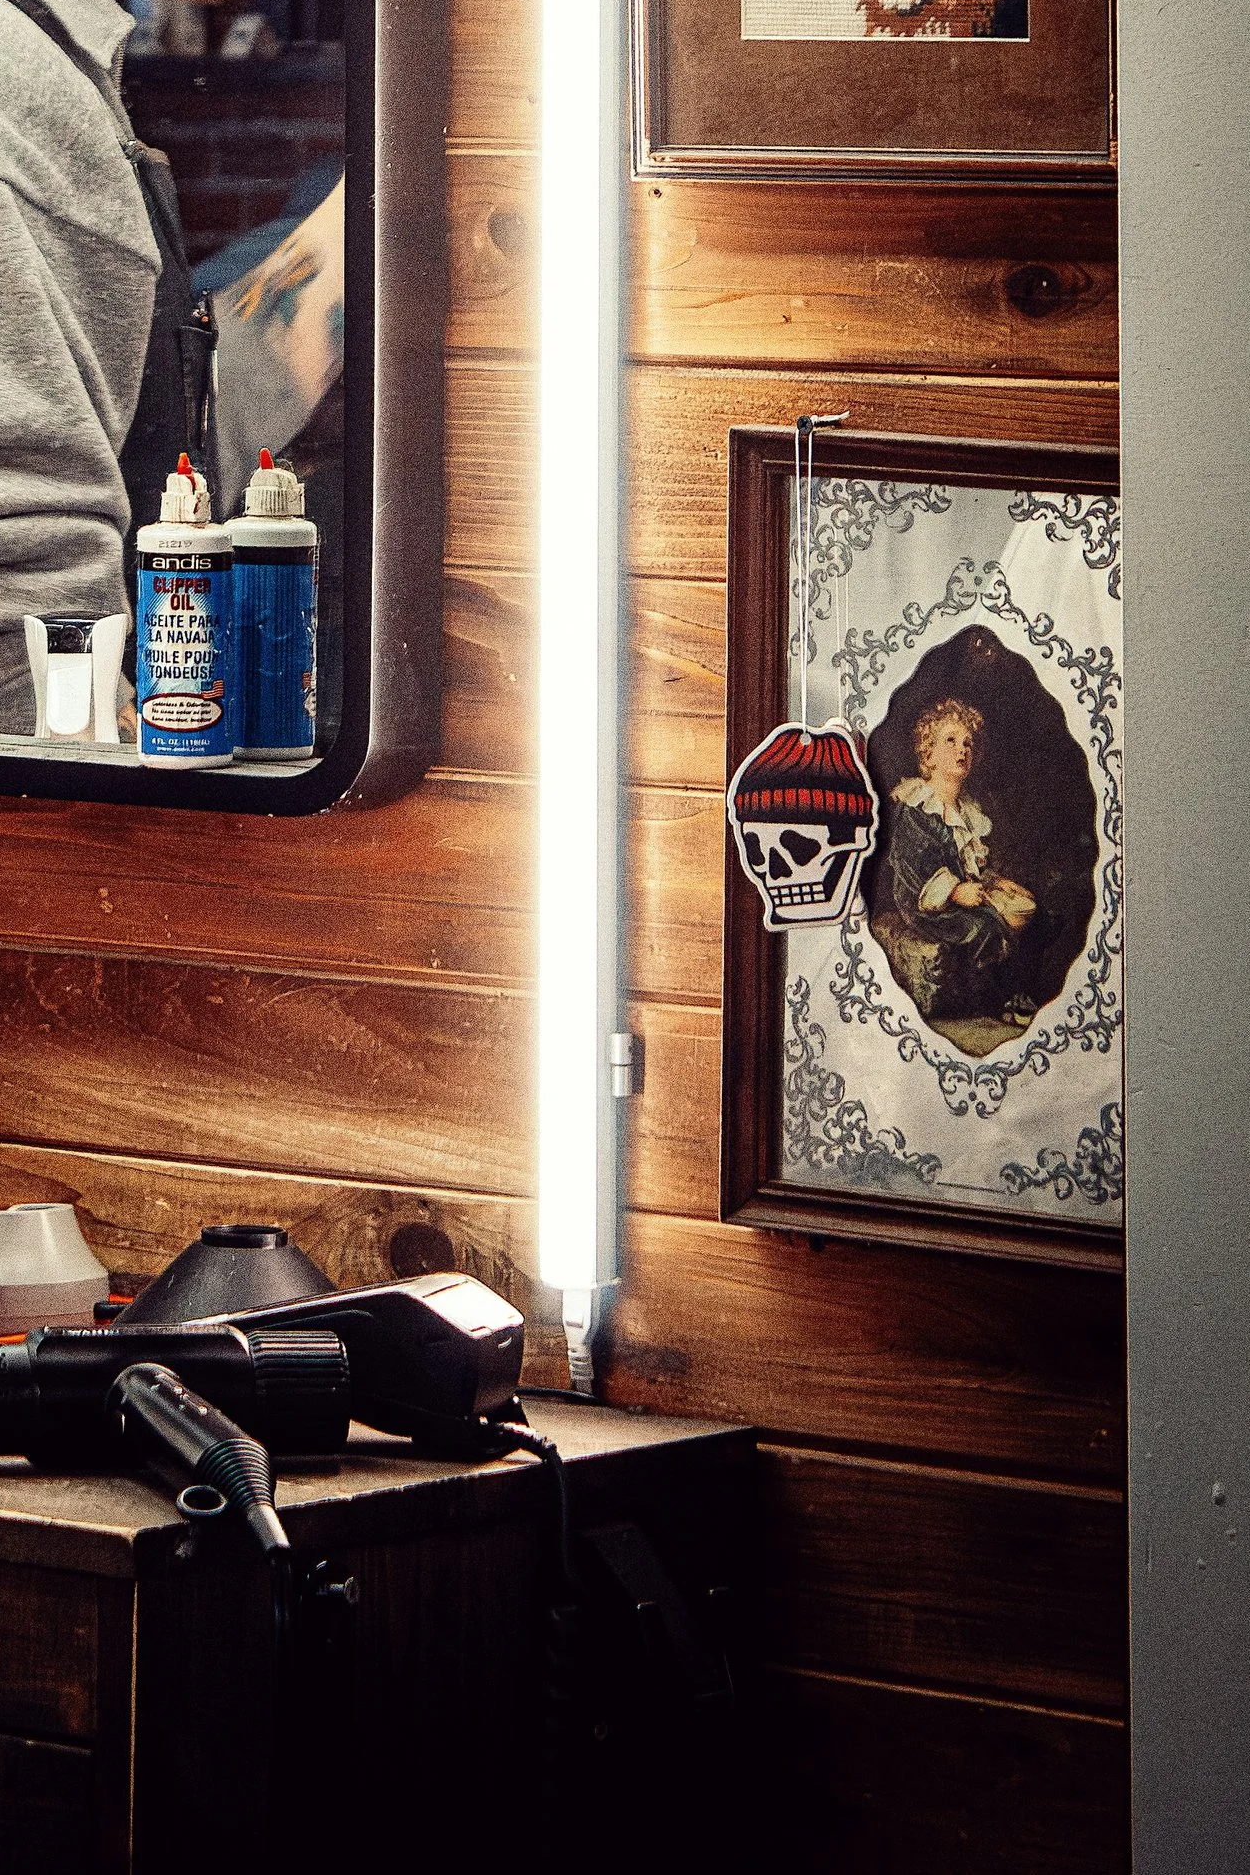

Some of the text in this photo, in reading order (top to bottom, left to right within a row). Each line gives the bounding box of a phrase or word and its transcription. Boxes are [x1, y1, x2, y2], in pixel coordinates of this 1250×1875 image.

[152, 554, 212, 570] andis
[170, 593, 195, 611] OIL
[144, 614, 184, 628] ACEITE
[150, 629, 215, 644] LA NAVAJA
[144, 650, 180, 664] HUILE
[150, 665, 215, 680] TONDEUSE
